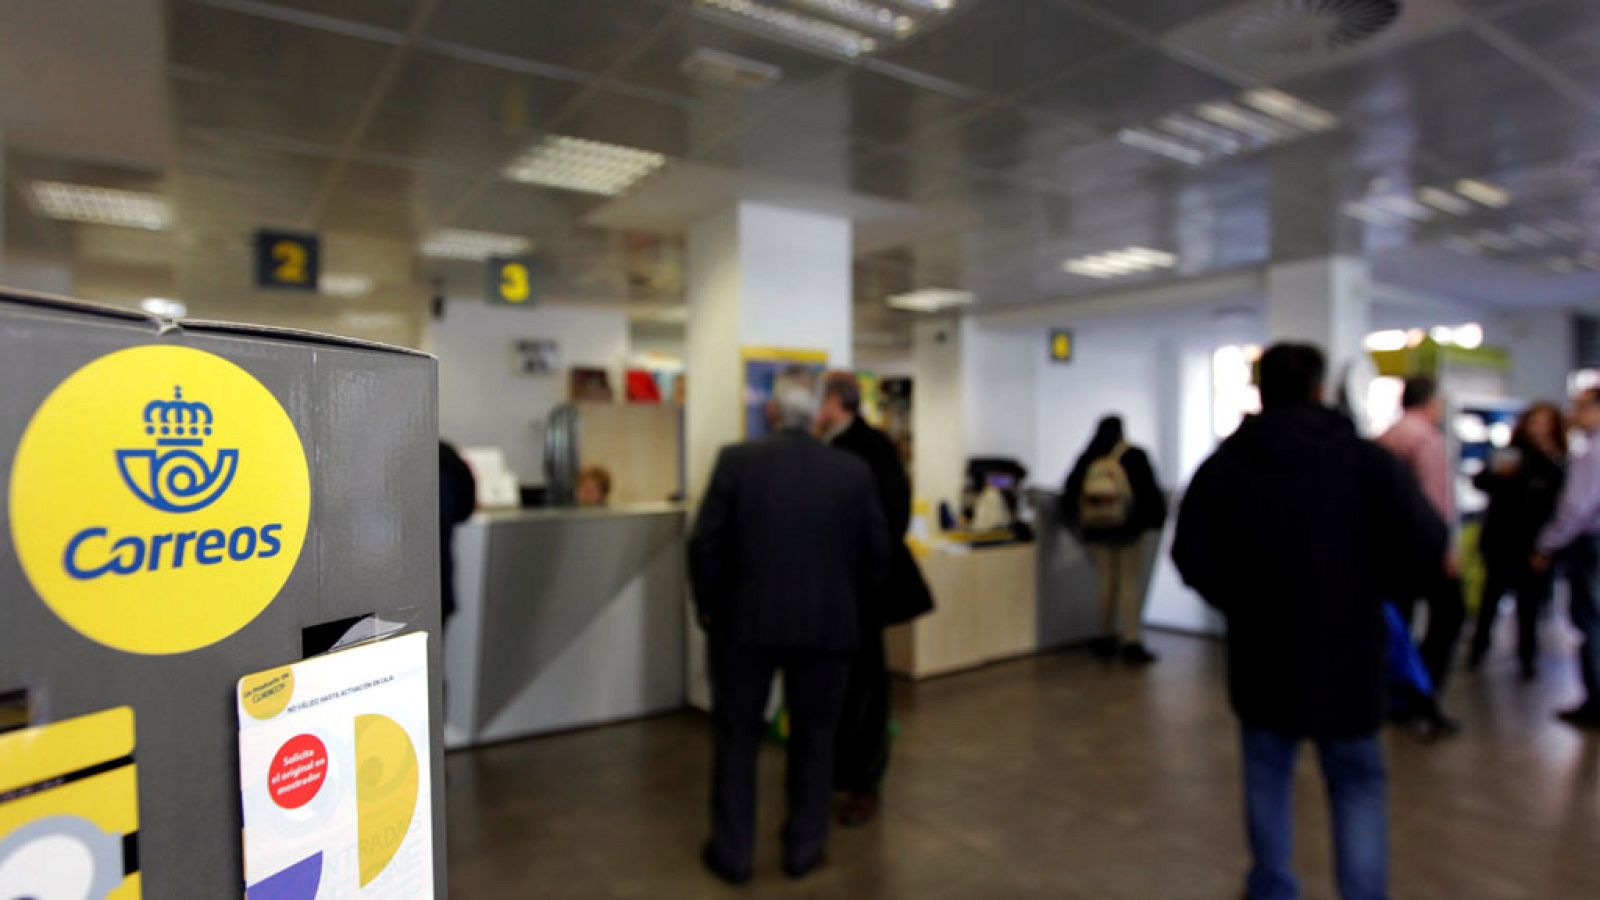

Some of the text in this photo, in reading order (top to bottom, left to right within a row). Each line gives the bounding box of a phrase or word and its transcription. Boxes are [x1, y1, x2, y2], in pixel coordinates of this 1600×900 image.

[272, 241, 306, 282] 2
[500, 262, 530, 304] 3
[63, 523, 282, 580] Correos
[320, 691, 340, 703] HASTA
[271, 757, 326, 784] el original en
[283, 749, 315, 767] Solicita
[277, 772, 321, 795] mostrador
